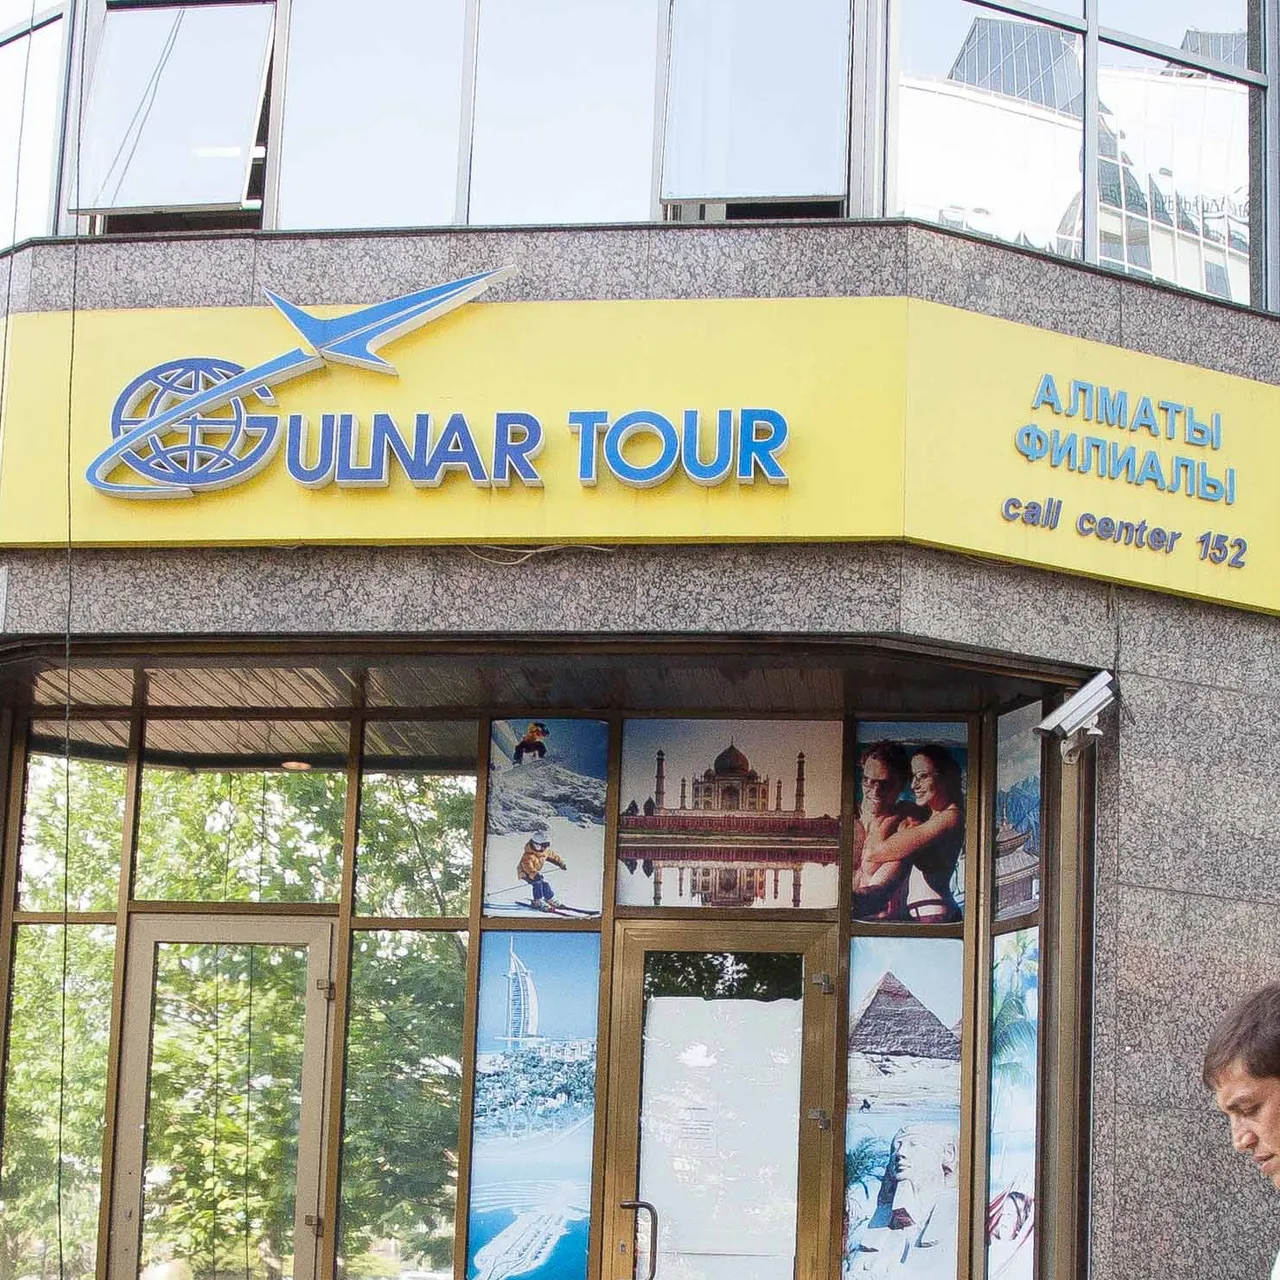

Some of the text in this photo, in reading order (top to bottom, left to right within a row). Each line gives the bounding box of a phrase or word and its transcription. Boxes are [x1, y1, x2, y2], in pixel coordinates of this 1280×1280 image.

[569, 408, 790, 489] TOUR
[1031, 372, 1221, 450] АЛМАТЫ
[1015, 423, 1236, 505] ФИЛИАЛЫ
[1001, 497, 1249, 569] call center 152
